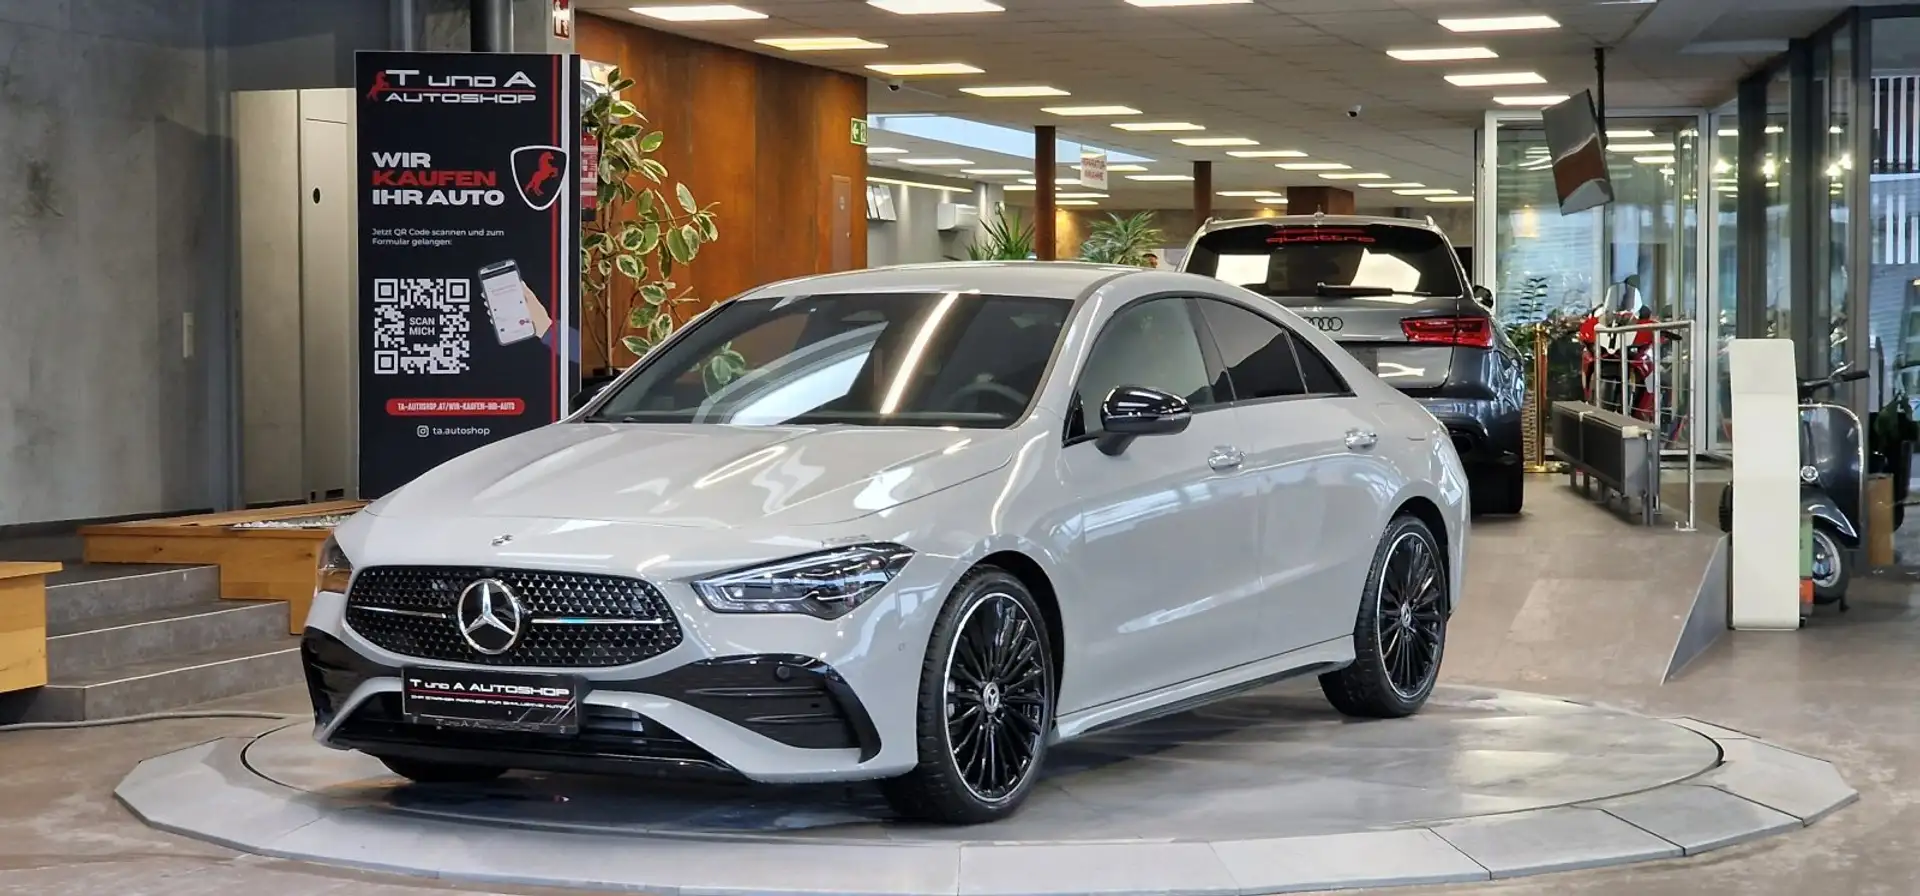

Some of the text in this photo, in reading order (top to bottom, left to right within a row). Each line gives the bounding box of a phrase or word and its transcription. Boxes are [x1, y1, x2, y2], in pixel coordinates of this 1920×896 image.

[385, 69, 420, 86] T
[503, 71, 536, 88] A
[385, 92, 537, 104] AUTOSHOP
[372, 152, 431, 168] WIR
[372, 170, 497, 186] KAUFEN
[372, 189, 506, 206] IHR AUTO
[372, 228, 392, 236] Jetzt
[393, 228, 407, 236] QR
[408, 228, 430, 236] Code
[431, 228, 466, 236] scannen
[468, 228, 485, 236] und
[409, 316, 435, 325] SCAN
[409, 326, 435, 335] MICH
[432, 426, 491, 436] ta.autoshop
[409, 678, 422, 688] T
[453, 682, 466, 691] A
[469, 683, 570, 697] AUTOSHOP
